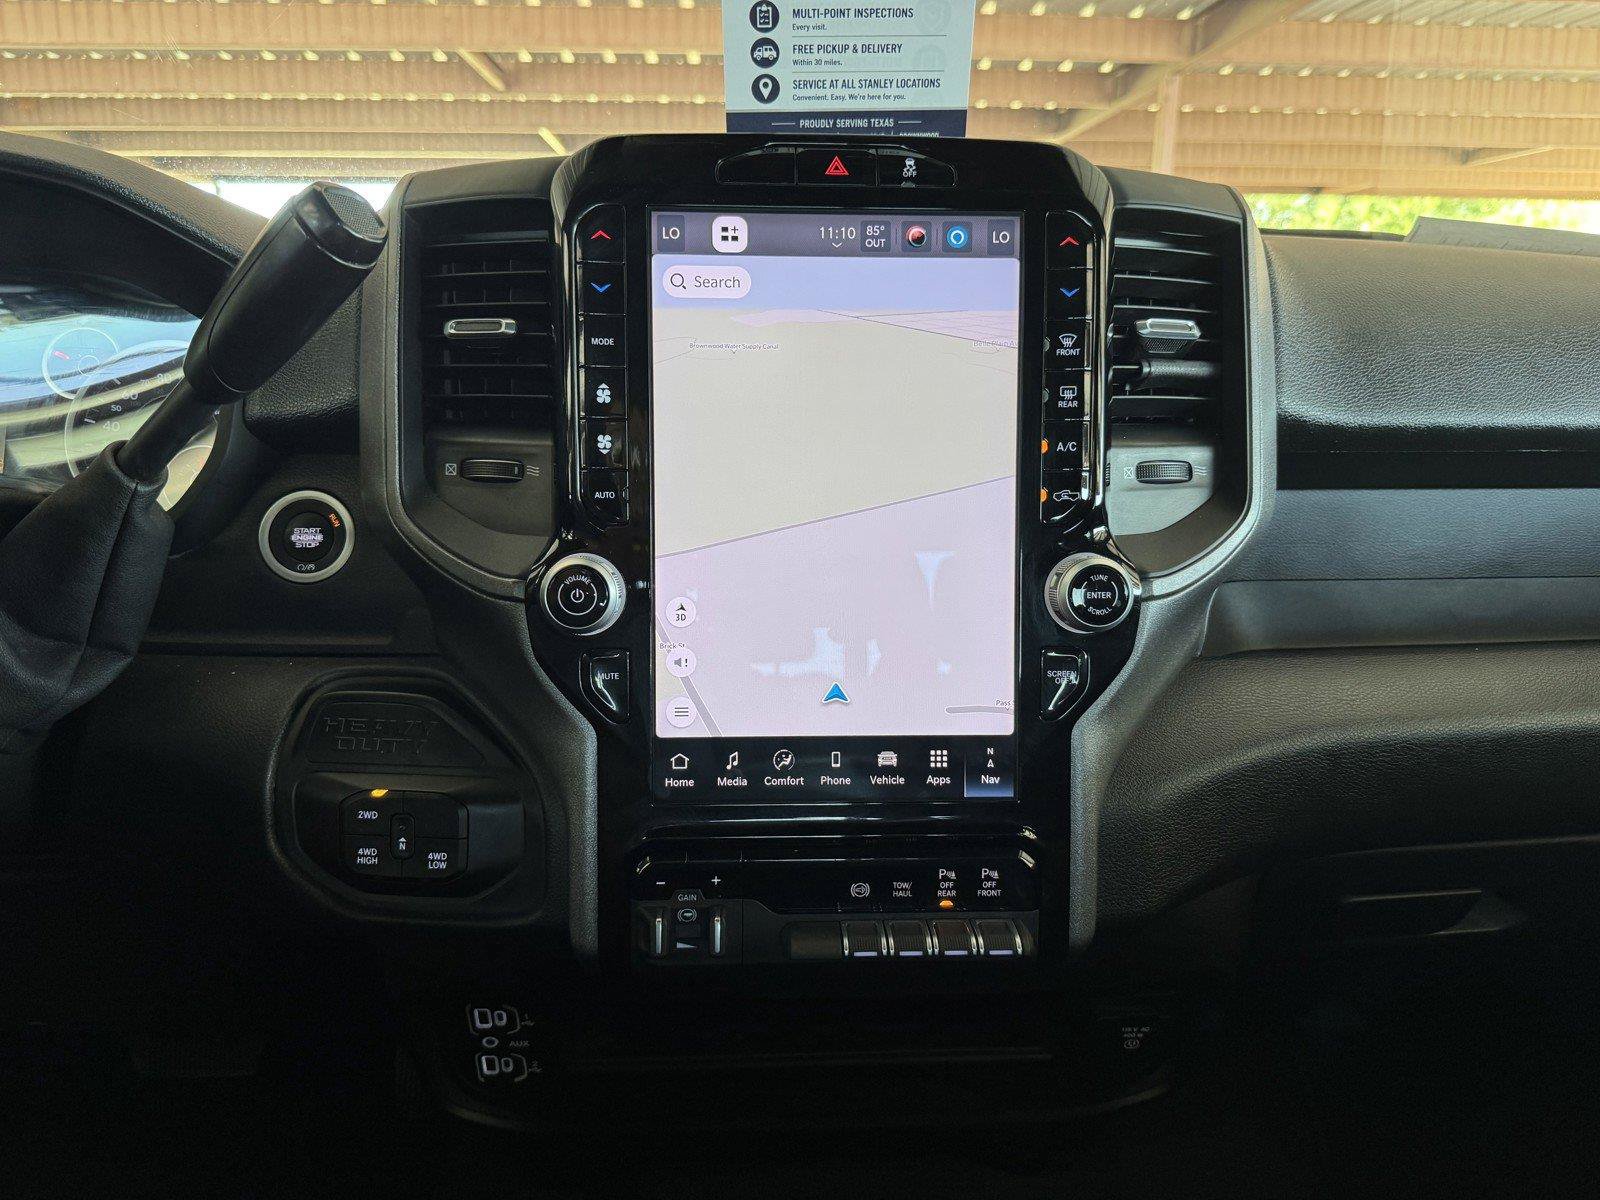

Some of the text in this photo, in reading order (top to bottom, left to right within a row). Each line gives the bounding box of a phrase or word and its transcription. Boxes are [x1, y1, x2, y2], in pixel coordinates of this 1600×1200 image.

[792, 7, 914, 19] MULTI-POINT INSPECTIONS
[792, 23, 828, 31] Every visit.
[792, 43, 903, 54] FREE PICKUP & DELIVERY
[792, 78, 941, 90] SERVICE AT ALL STANLEY LOCATIONS
[848, 93, 866, 101] We're
[799, 118, 894, 129] PROUDLY SERVING TEXAS
[662, 226, 680, 240] LO
[819, 226, 856, 239] 11:10
[866, 225, 885, 236] 85°
[992, 231, 1010, 244] LO
[865, 238, 886, 248] OUT
[694, 275, 741, 289] Search
[591, 337, 615, 346] MODE
[742, 343, 761, 351] Supply
[1056, 348, 1081, 356] FRONT
[111, 404, 122, 412] 50
[1058, 400, 1078, 408] REAR
[102, 420, 120, 432] 40
[1056, 441, 1077, 451] A/C
[594, 491, 616, 499] AUTO
[328, 512, 341, 528] RUN
[564, 574, 592, 586] VOLUME
[1090, 574, 1109, 582] TUNE
[1086, 591, 1112, 599] ENTER
[1087, 606, 1113, 616] SCROLL
[675, 613, 687, 622] 3D
[597, 671, 620, 680] MUTE
[1046, 670, 1077, 678] SCREEN
[665, 775, 1001, 787] Home Media Comfort Phone Vehicle Apps Nav
[358, 811, 378, 819] 2WD
[399, 842, 406, 850] N
[357, 848, 378, 856] 4WD
[356, 857, 378, 865] HIGH
[428, 861, 448, 869] LOW
[892, 882, 913, 890] TOW/
[982, 881, 997, 889] OFF
[677, 893, 698, 902] GAIN
[977, 889, 1002, 897] FRONT
